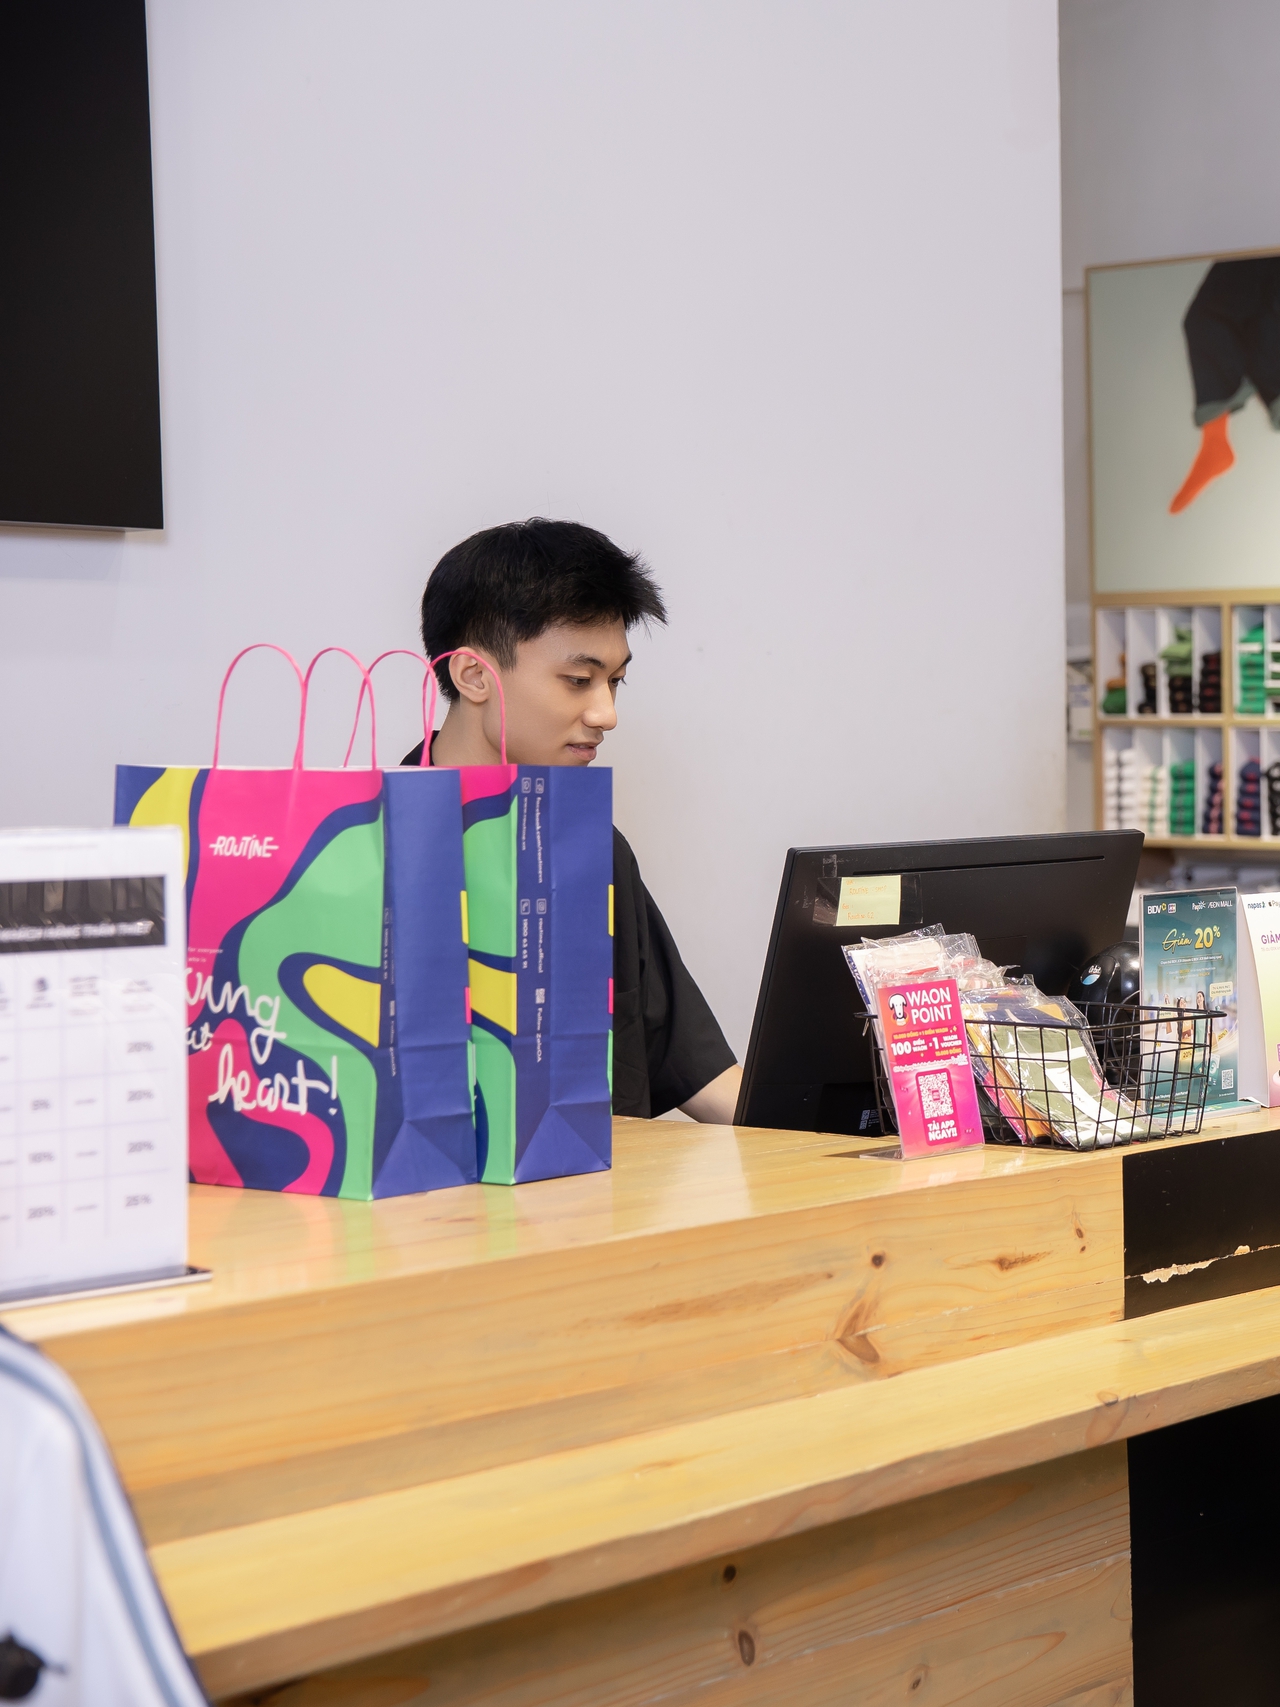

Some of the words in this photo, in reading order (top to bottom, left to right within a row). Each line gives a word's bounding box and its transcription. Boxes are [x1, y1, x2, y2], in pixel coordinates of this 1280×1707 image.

[209, 834, 279, 859] ROUTINE
[1147, 905, 1162, 914] BIDV
[1194, 925, 1221, 949] 20%
[906, 987, 951, 1007] WAON
[911, 1004, 952, 1025] POINT
[890, 1041, 912, 1056] 100
[932, 1037, 939, 1050] 1
[941, 1040, 962, 1048] VOUCHER
[927, 1120, 940, 1132] TẢI
[940, 1119, 955, 1130] APP
